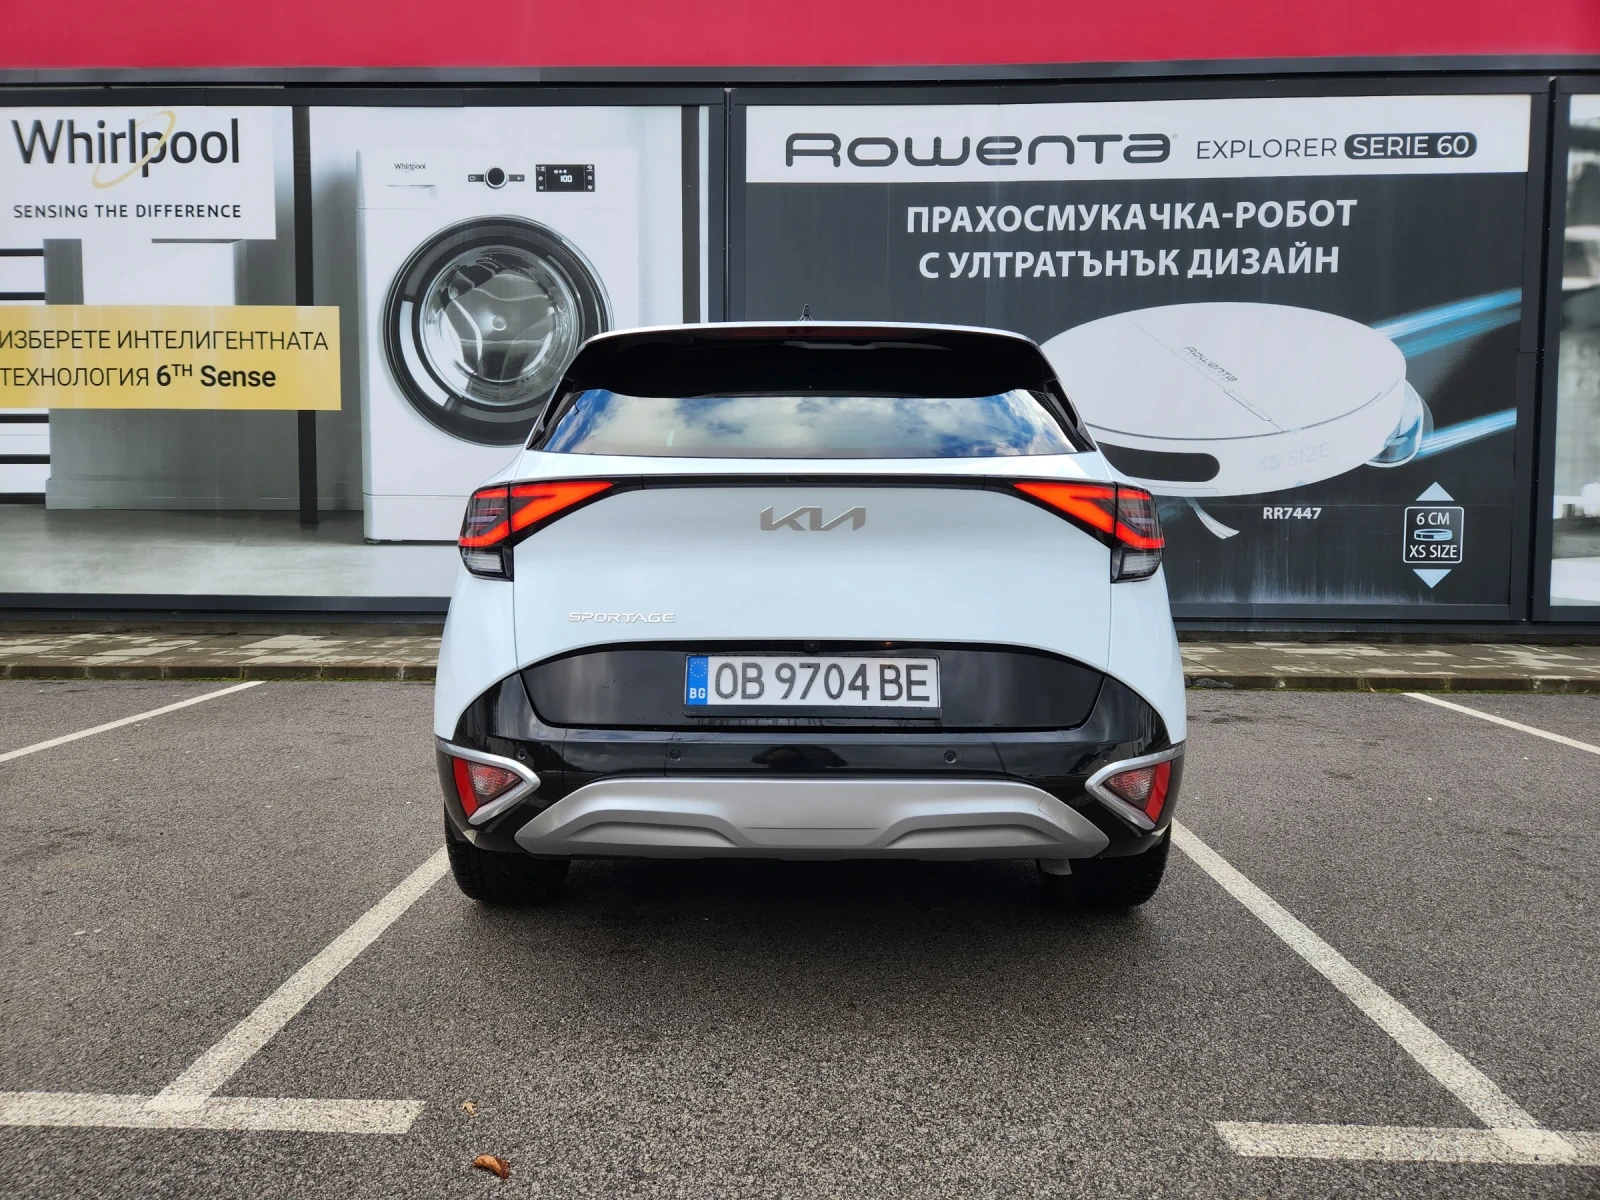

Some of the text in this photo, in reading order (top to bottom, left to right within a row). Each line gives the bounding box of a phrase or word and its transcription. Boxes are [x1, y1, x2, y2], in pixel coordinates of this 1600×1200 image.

[11, 117, 240, 178] Whirlpool
[1196, 134, 1470, 160] EXPLORER SERIE 60
[393, 162, 426, 172] Whirlpool
[13, 204, 242, 218] SENSING THE DIFFERENCE
[906, 199, 1358, 233] ПРАХОСМУКАЧКА-РОБОТ
[918, 241, 1340, 279] С УЛТРАТЪНЪК ДИЗАЙН
[0, 330, 329, 350] ИЗБЕРЕТЕ ИНТЕЛИГЕНТНАТА
[0, 368, 150, 387] ТЕХНОЛОГИЯ
[200, 365, 277, 387] Sense
[1263, 506, 1322, 520] RR7447
[1416, 512, 1450, 526] 6 CM
[1409, 544, 1458, 558] XS SIZE
[568, 611, 676, 623] SPORTAGE
[774, 661, 870, 701] 9704
[879, 664, 931, 702] BE
[689, 687, 707, 700] BG
